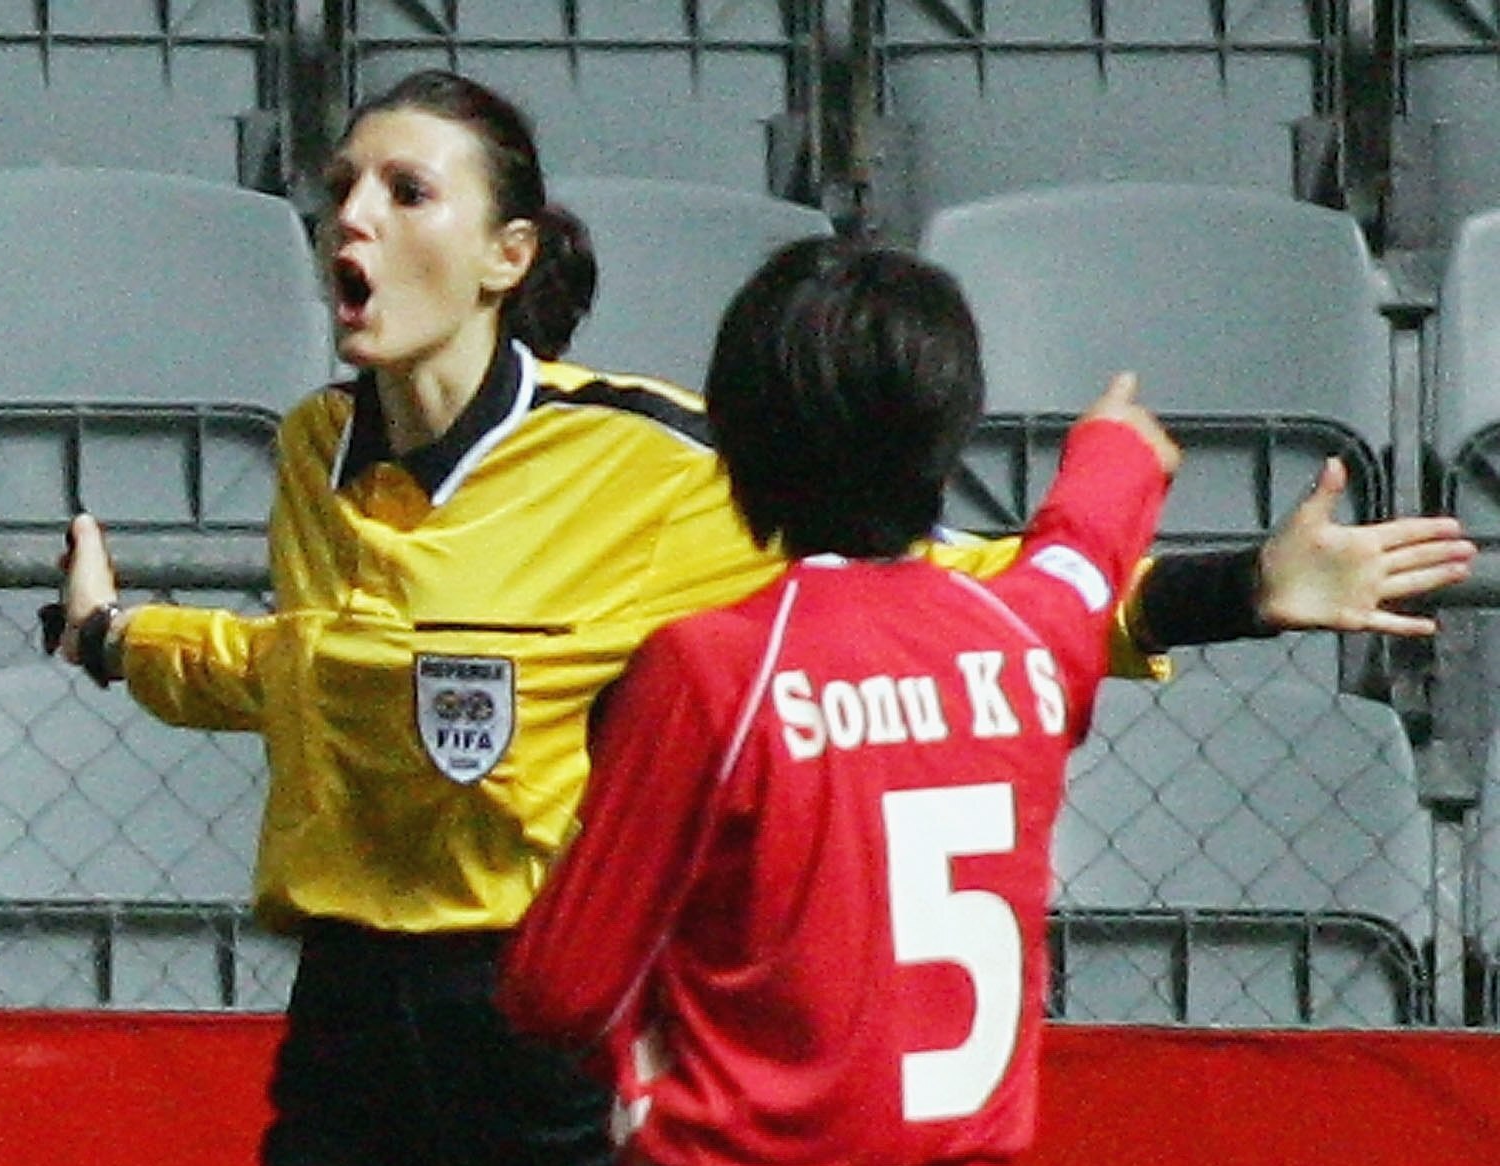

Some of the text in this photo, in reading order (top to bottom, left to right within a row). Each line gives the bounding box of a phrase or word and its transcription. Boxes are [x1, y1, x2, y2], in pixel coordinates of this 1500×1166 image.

[436, 729, 493, 749] FIFA
[772, 647, 1066, 760] Sonu K S
[881, 782, 1022, 1123] 5
